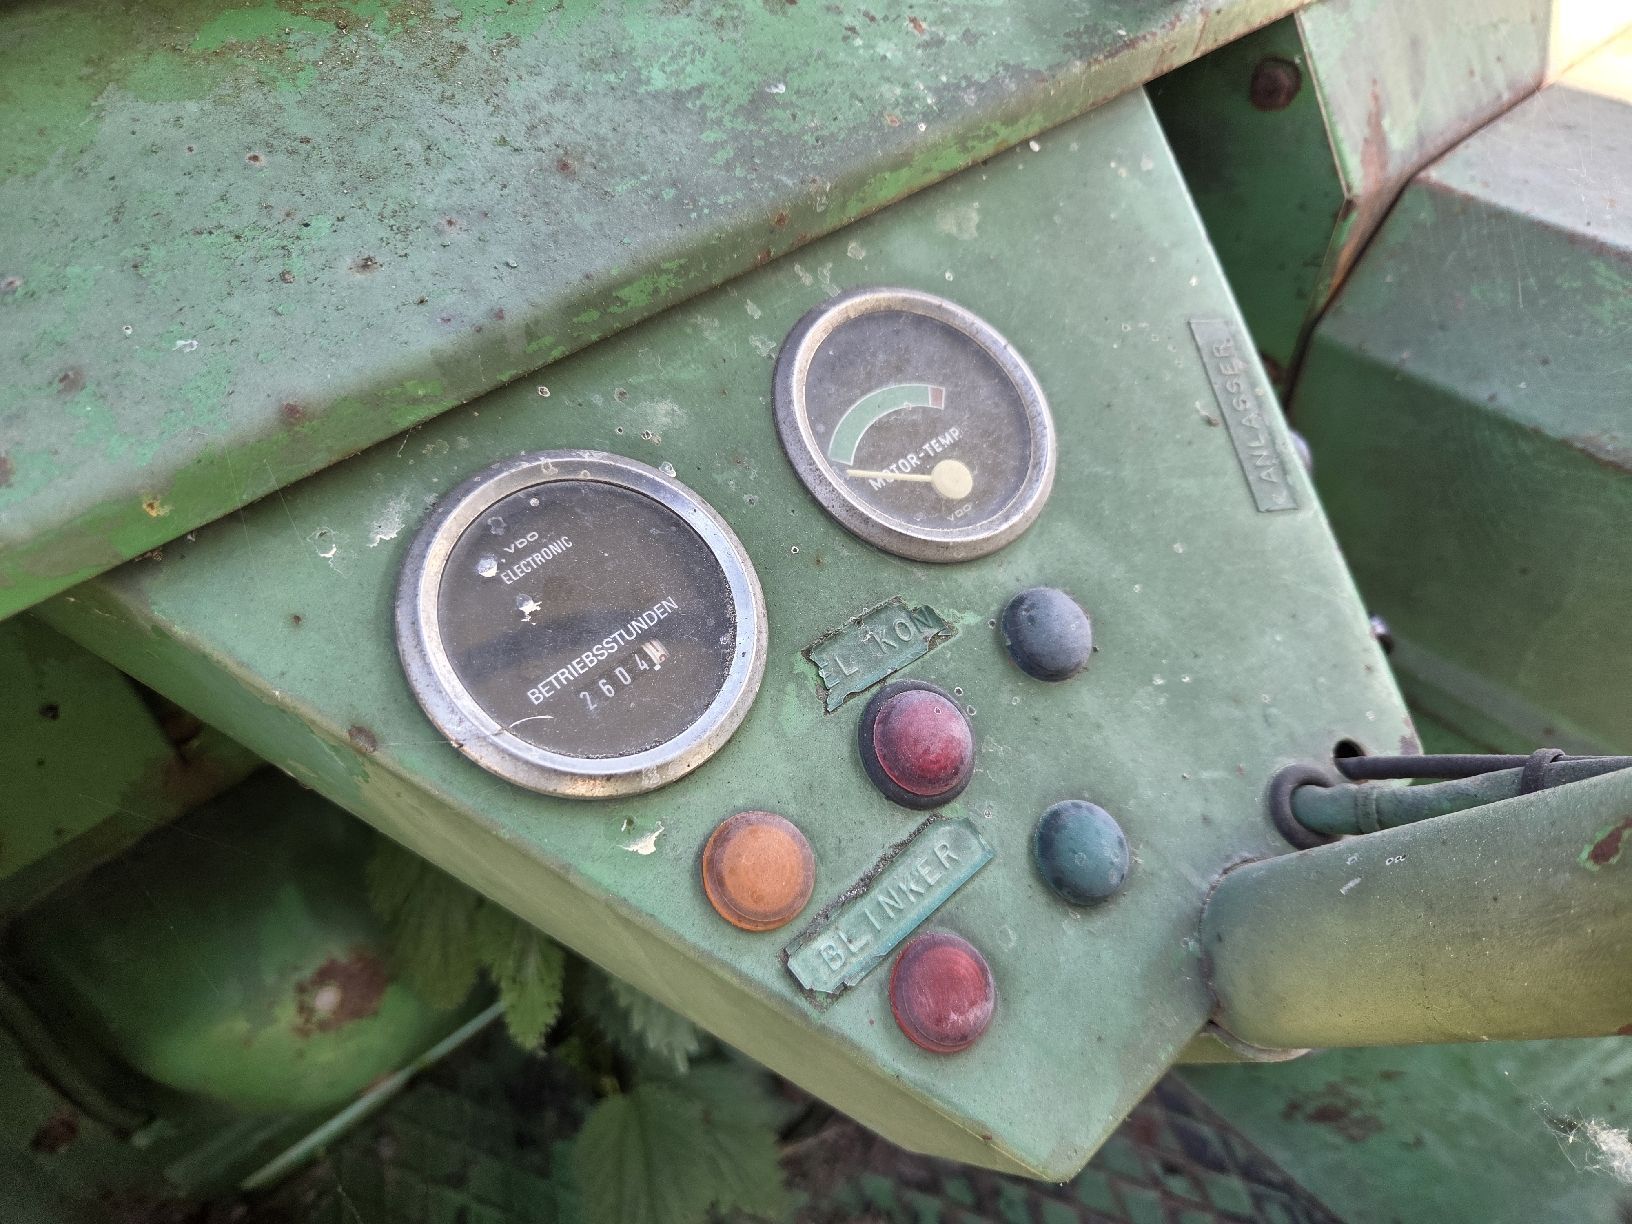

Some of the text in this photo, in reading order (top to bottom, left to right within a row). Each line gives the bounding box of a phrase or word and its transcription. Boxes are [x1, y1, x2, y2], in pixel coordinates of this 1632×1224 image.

[1211, 338, 1281, 485] ANLASSER
[503, 531, 539, 554] VDO
[946, 503, 973, 522] VDO
[500, 536, 573, 585] ELECTRONIC
[526, 595, 680, 706] BETRIEBSSTUNDEN
[818, 841, 961, 972] BLINKER
